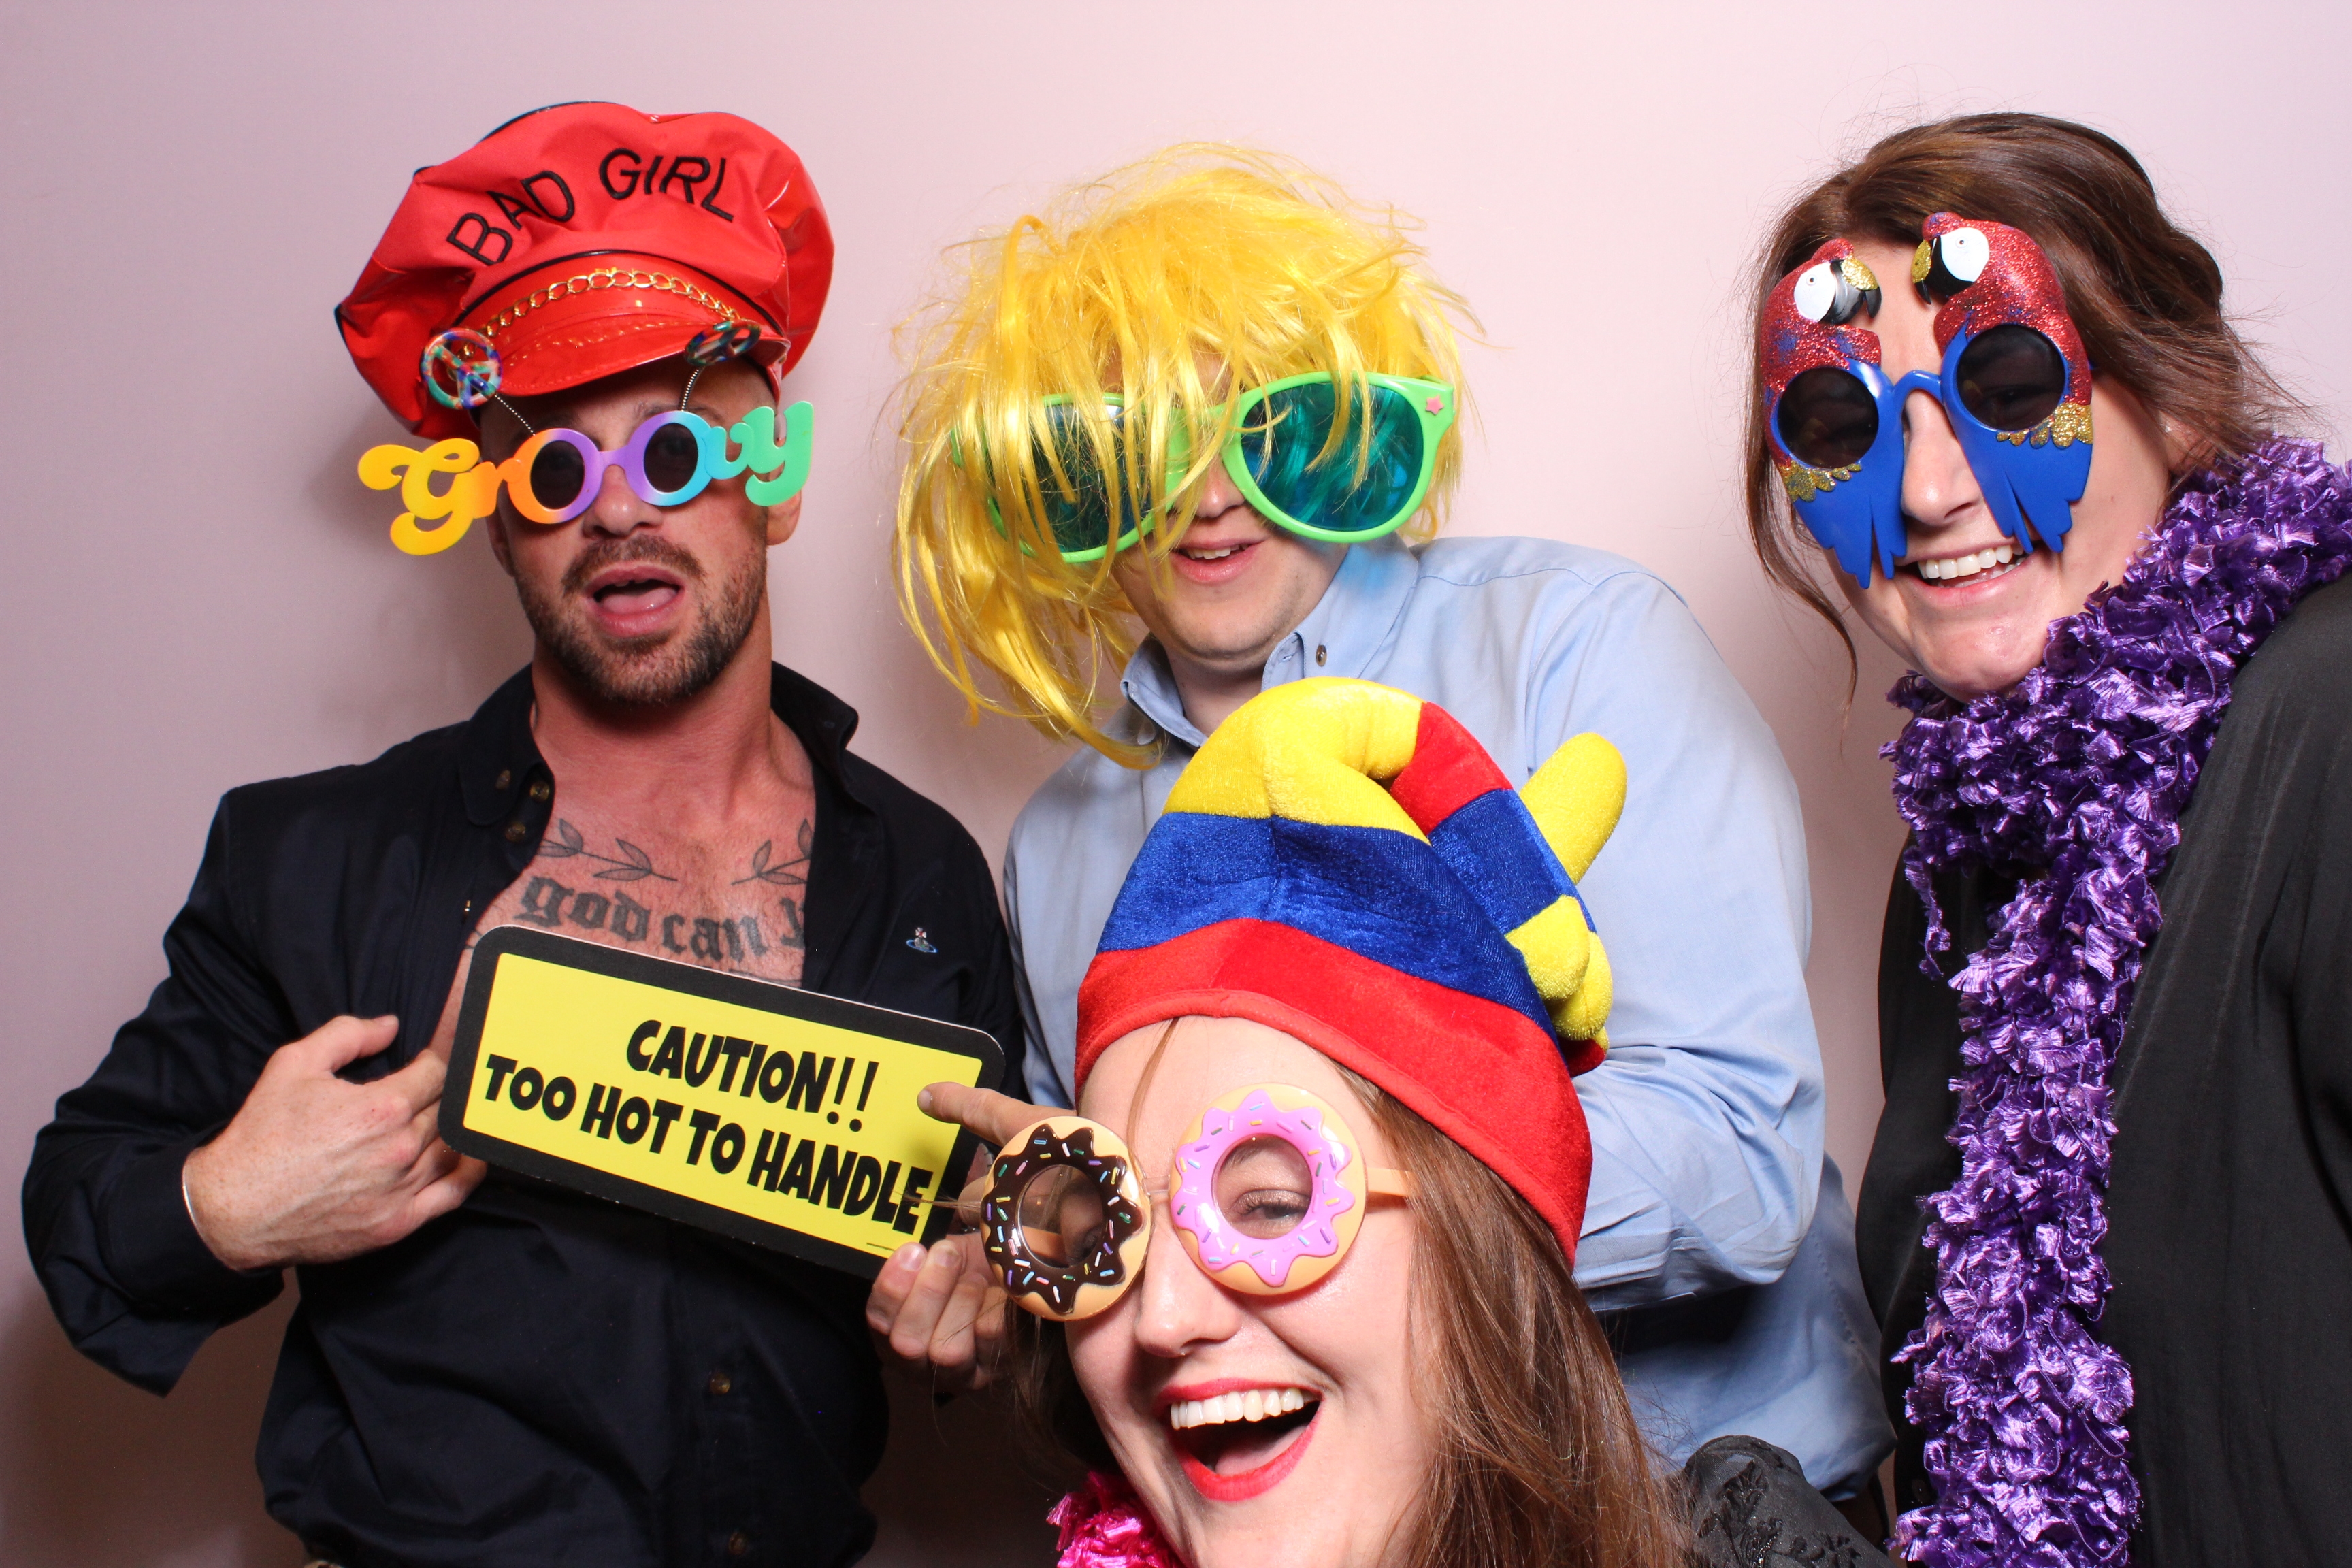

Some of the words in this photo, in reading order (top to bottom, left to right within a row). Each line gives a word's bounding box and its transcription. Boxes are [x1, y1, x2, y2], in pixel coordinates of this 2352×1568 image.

[446, 170, 576, 266] BAD
[599, 148, 736, 223] GIRL
[660, 913, 769, 963] can
[626, 1019, 879, 1132] CAUTION!!
[485, 1053, 577, 1121] TOO
[579, 1082, 684, 1154] HOT
[685, 1109, 746, 1175] TO
[746, 1128, 934, 1235] HANDLE
